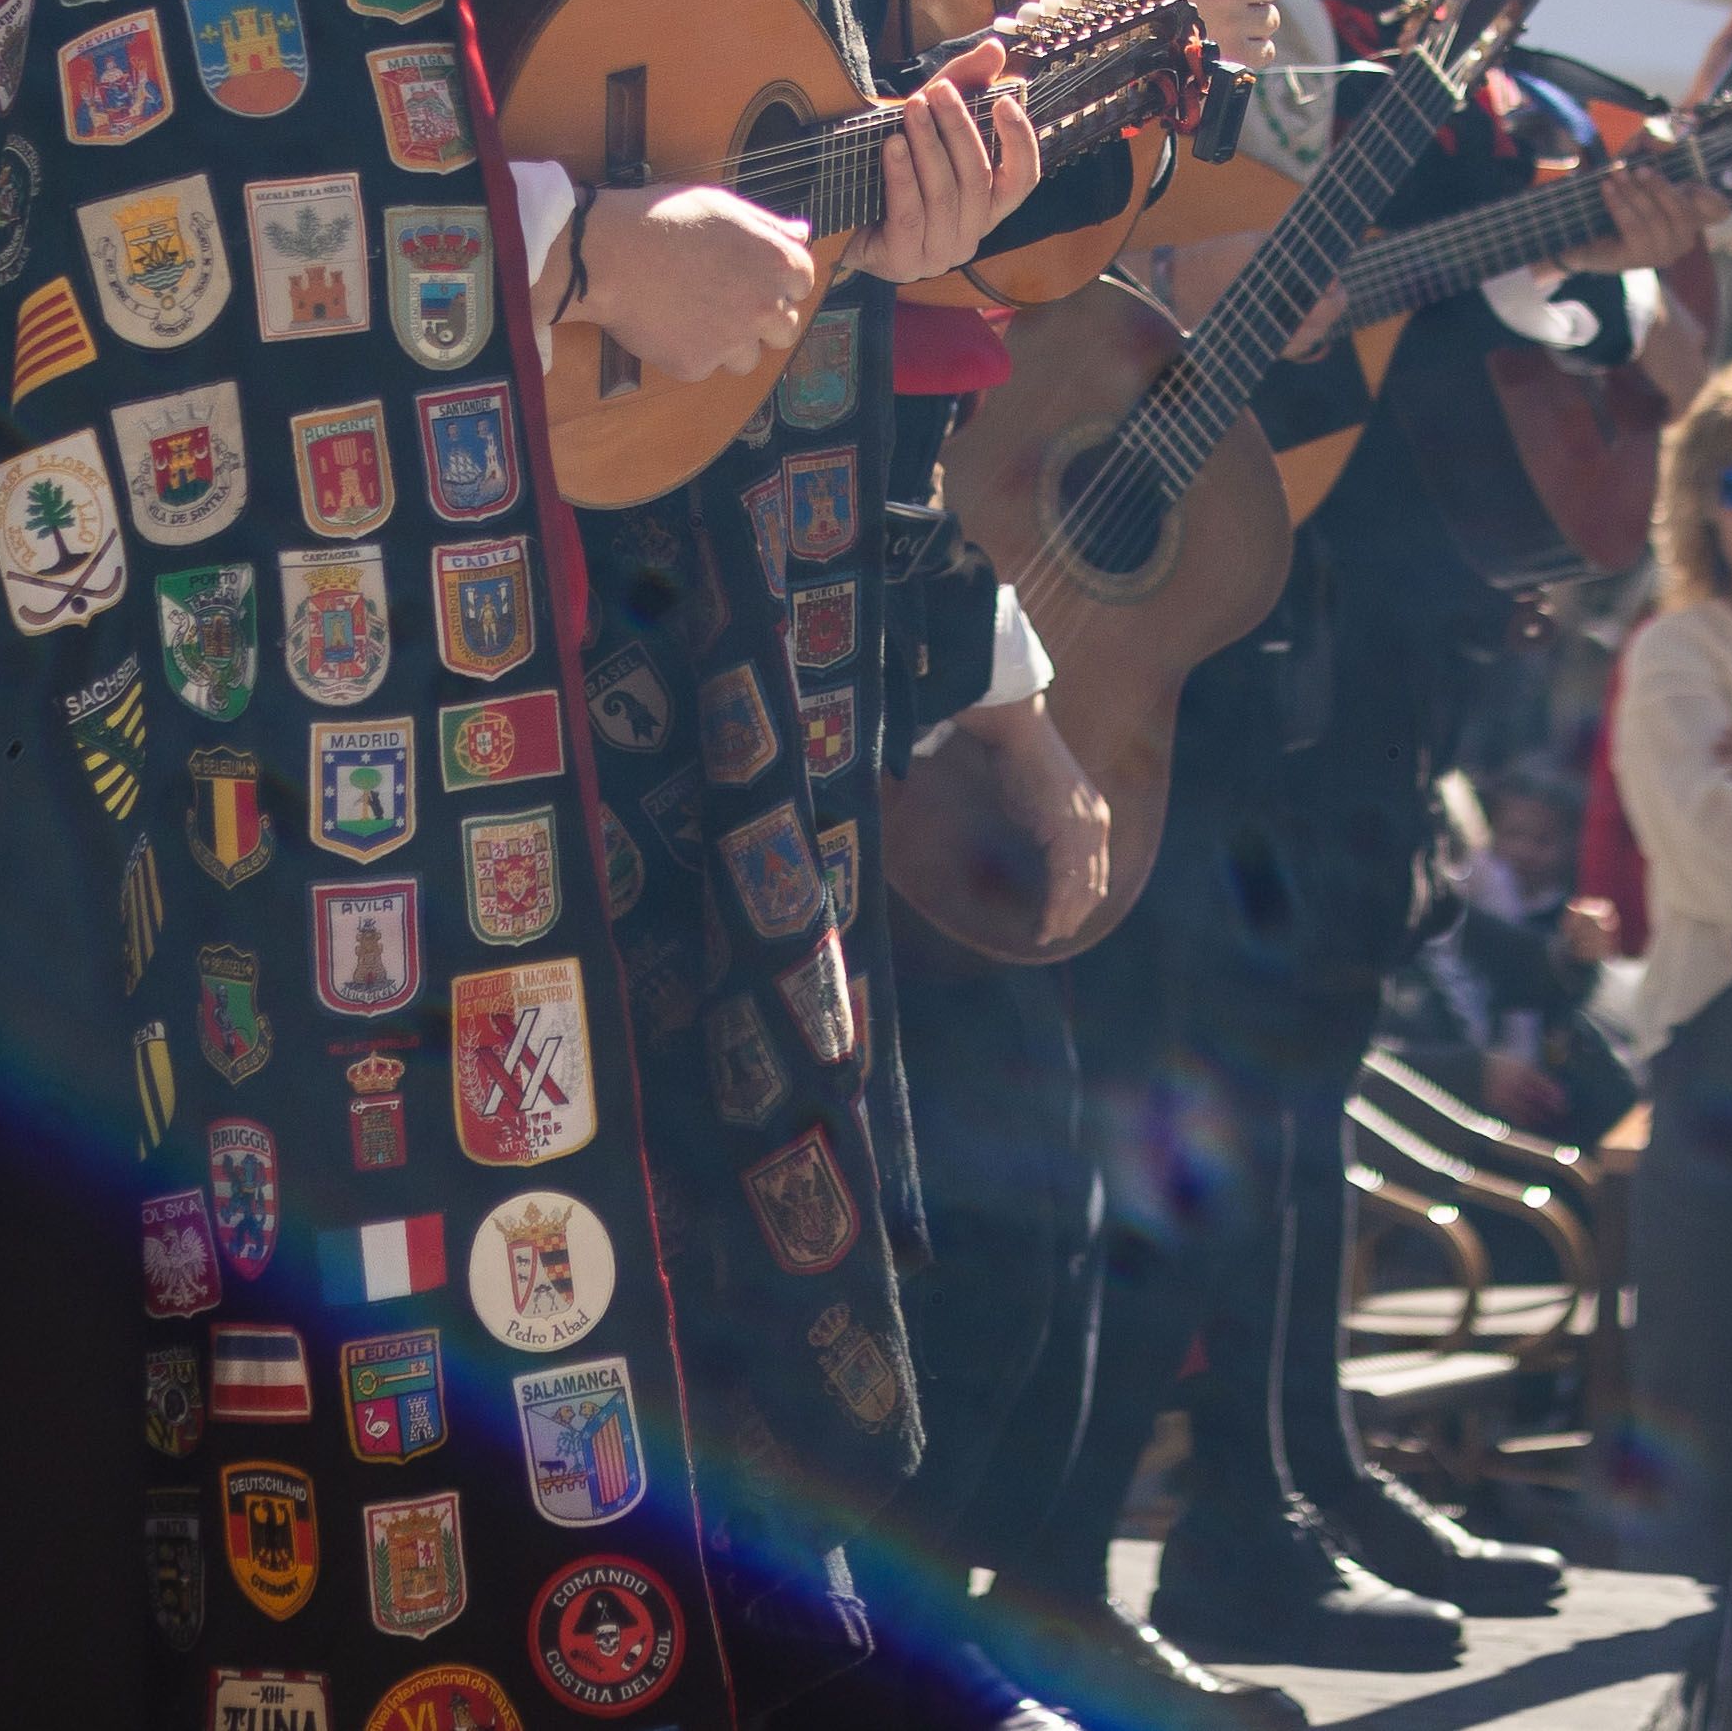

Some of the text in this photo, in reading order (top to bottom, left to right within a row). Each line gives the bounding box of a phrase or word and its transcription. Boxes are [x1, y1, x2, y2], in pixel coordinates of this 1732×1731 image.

[76, 22, 141, 53] SEVILLA
[386, 55, 446, 70] MALAGA
[438, 398, 492, 417] SANTANDER
[304, 415, 375, 441] ALICANTE
[170, 514, 187, 525] DE
[190, 485, 230, 522] SINTRA
[301, 550, 361, 563] CARTAGENA
[452, 549, 514, 568] CADIZ
[189, 571, 237, 586] PORTO
[805, 585, 845, 602] MURCIA
[585, 656, 638, 700] BASEL
[330, 732, 400, 749] MADRID
[819, 834, 847, 855] DRID
[341, 899, 394, 915] AVILA
[523, 966, 572, 988] NACIONAL
[212, 1128, 271, 1153] BRUGGE
[498, 1138, 551, 1153] MURCIA
[142, 1199, 201, 1224] OLSKA
[505, 1308, 591, 1344] Pedro Abad
[355, 1340, 429, 1361] LEUCATE
[521, 1368, 622, 1403] SALAMANCA
[229, 1474, 308, 1503] DEUTSCHLAND
[250, 1573, 300, 1598] GERMANY
[553, 1569, 648, 1608] COMANDO
[546, 1629, 671, 1704] COSTRA DEL SOL
[388, 1671, 470, 1710] Internacional
[470, 1676, 487, 1694] de
